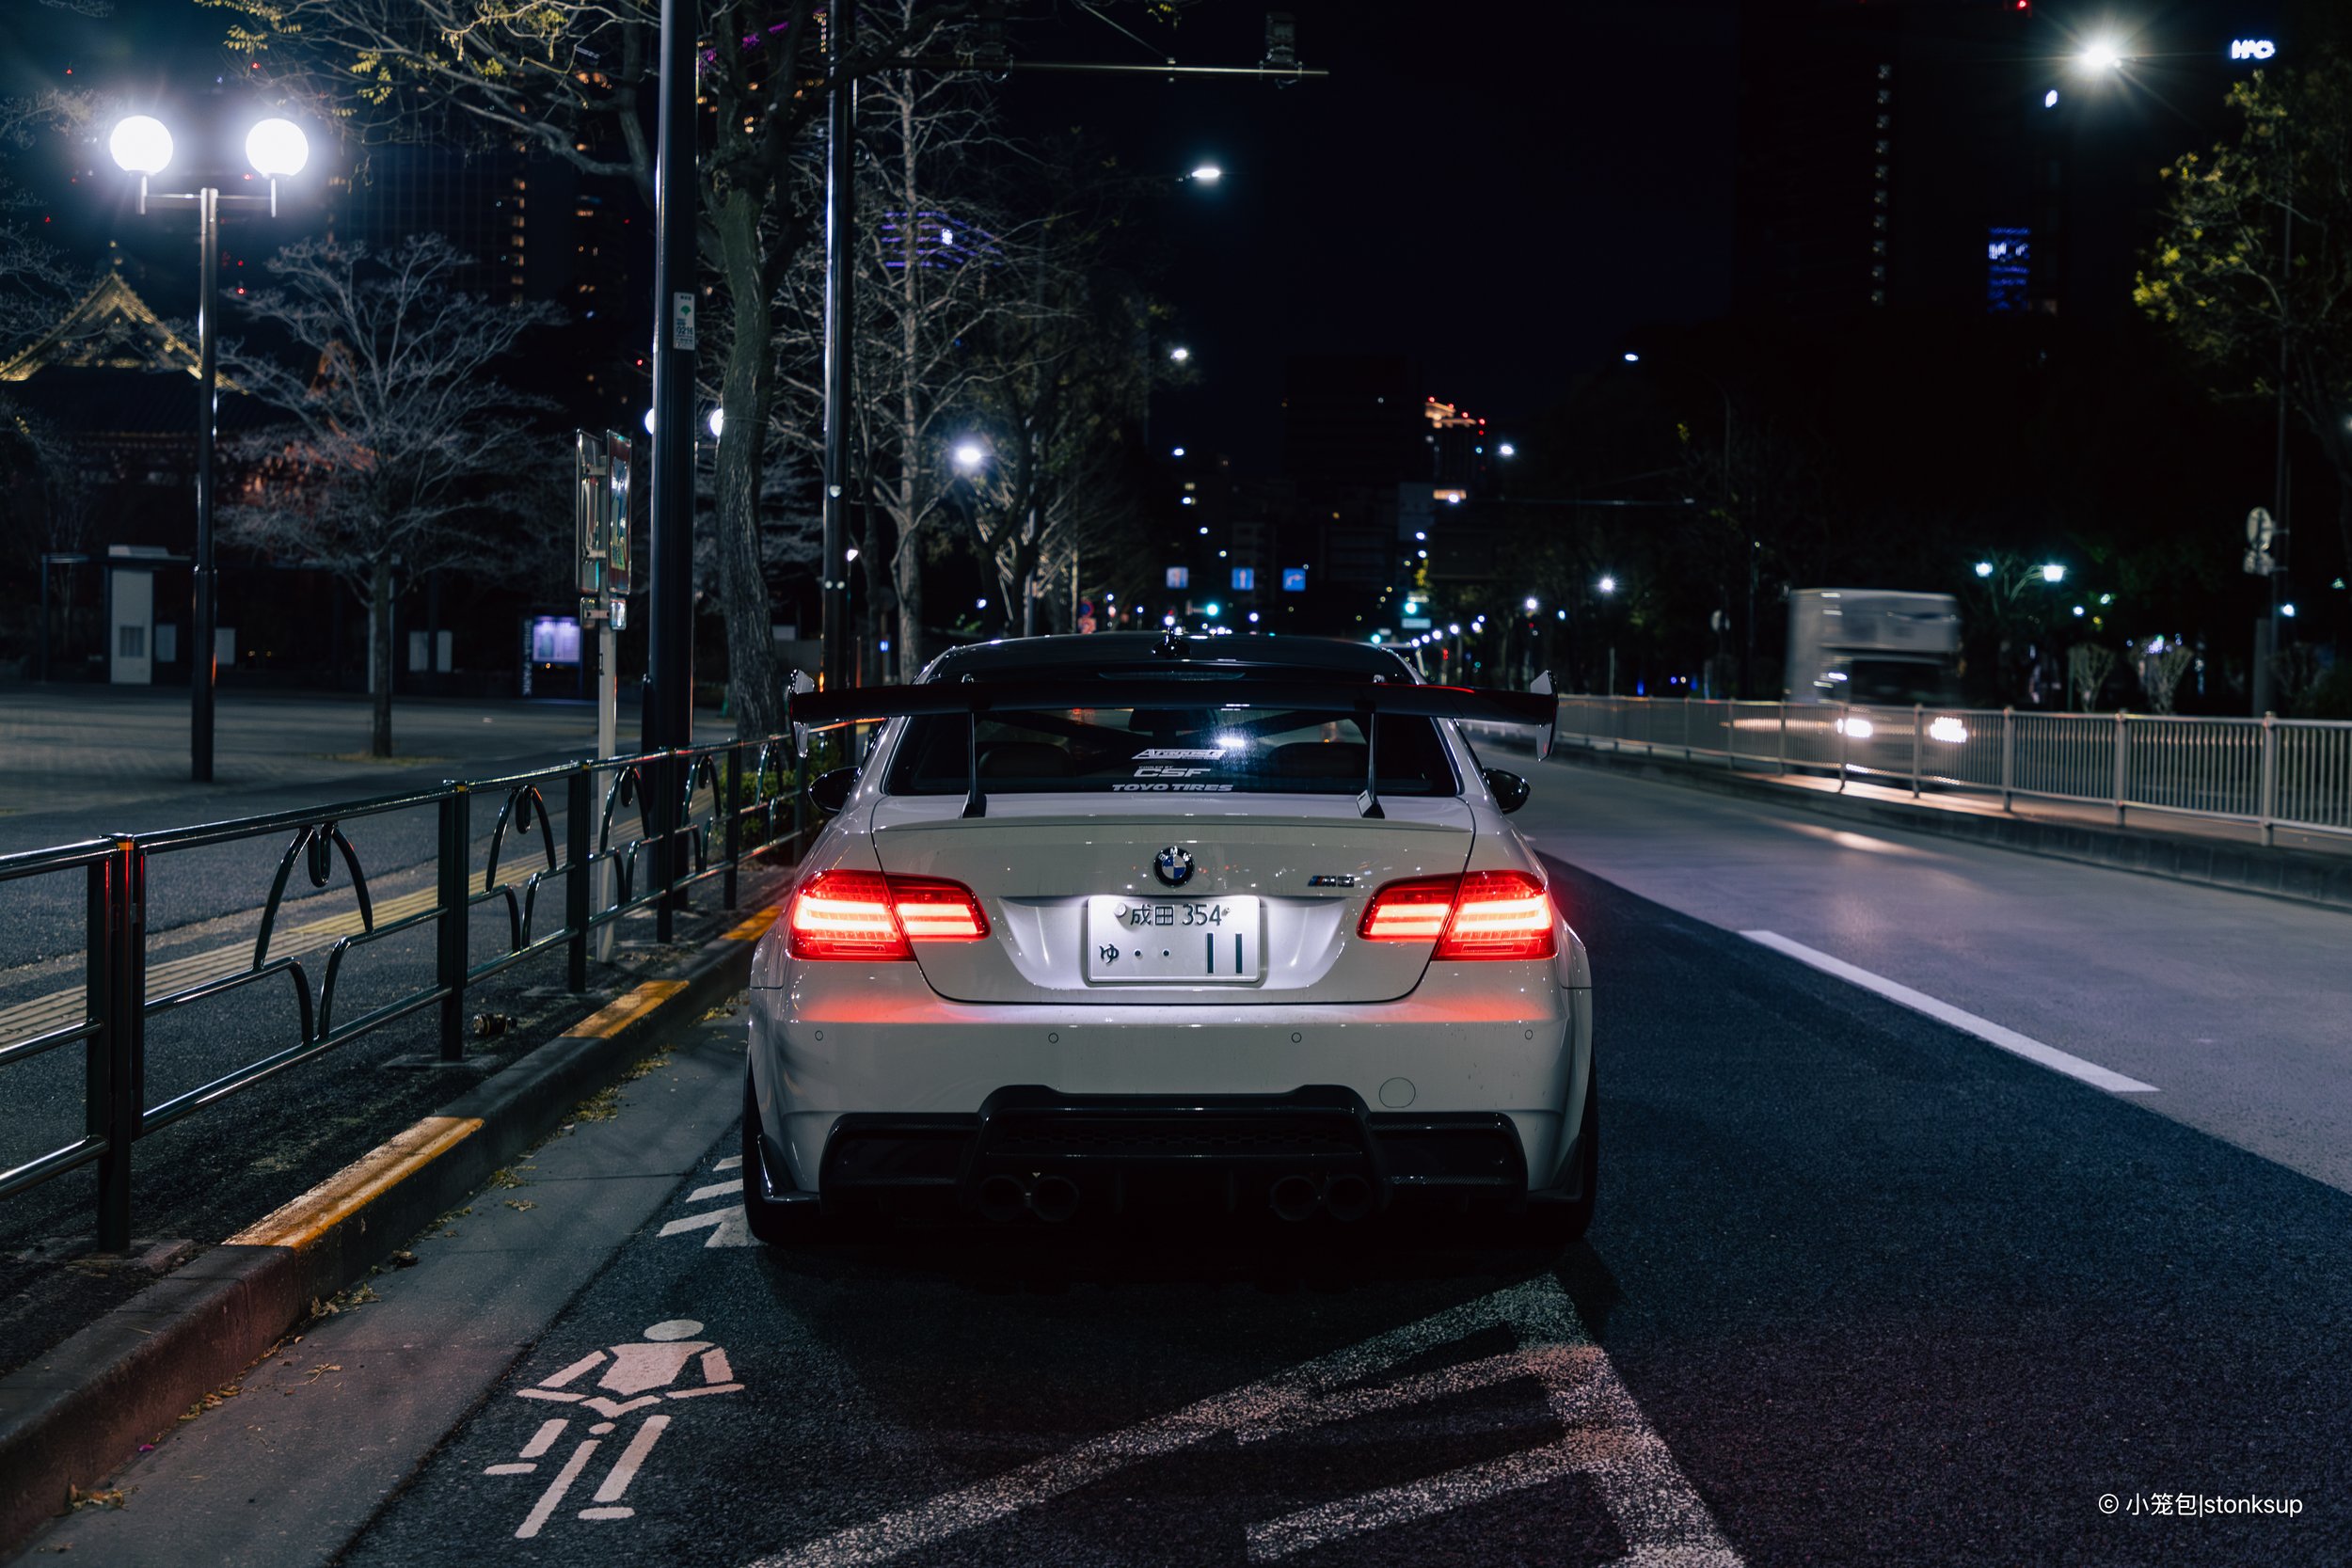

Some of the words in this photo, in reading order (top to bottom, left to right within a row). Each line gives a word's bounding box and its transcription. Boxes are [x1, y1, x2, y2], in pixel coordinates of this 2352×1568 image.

[1134, 768, 1211, 777] CSF
[1172, 784, 1233, 792] TIRES
[1158, 846, 1190, 862] BMW
[1130, 904, 1174, 926] 成田
[1182, 904, 1222, 927] 354
[1099, 943, 1120, 964] ゆ
